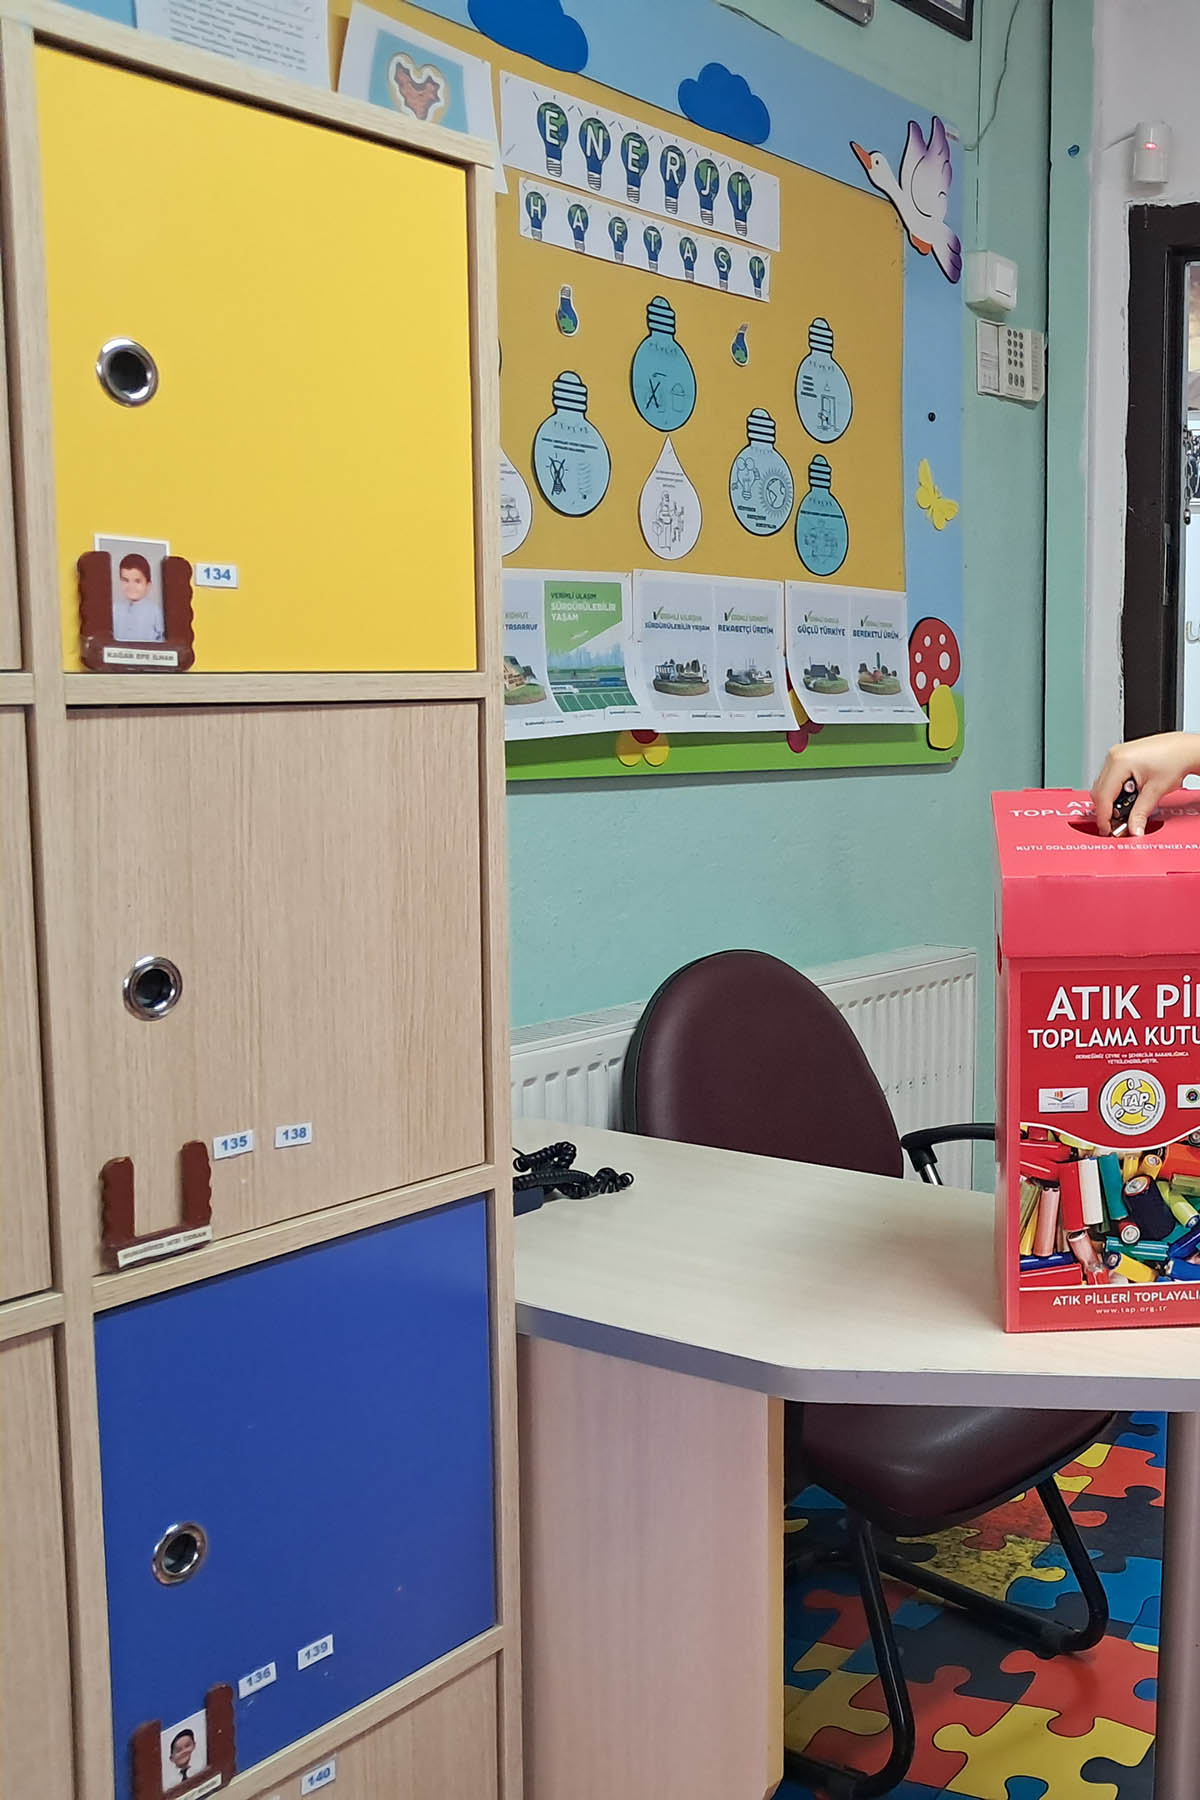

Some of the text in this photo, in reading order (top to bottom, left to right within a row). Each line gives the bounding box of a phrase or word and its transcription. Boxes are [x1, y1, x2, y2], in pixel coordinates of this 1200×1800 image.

[544, 109, 744, 211] ENERJİ
[529, 195, 761, 277] HAFTASI
[203, 566, 232, 582] 134
[1047, 984, 1141, 1022] ATIK
[1028, 1026, 1138, 1048] TOPLAMA
[1123, 1092, 1150, 1108] TAP
[220, 1127, 307, 1151] 135 138
[1052, 1295, 1081, 1306] ATIK
[1084, 1292, 1131, 1305] PİLLERİ
[304, 1640, 329, 1660] 139
[246, 1667, 272, 1687] 136
[308, 1767, 331, 1786] 140
